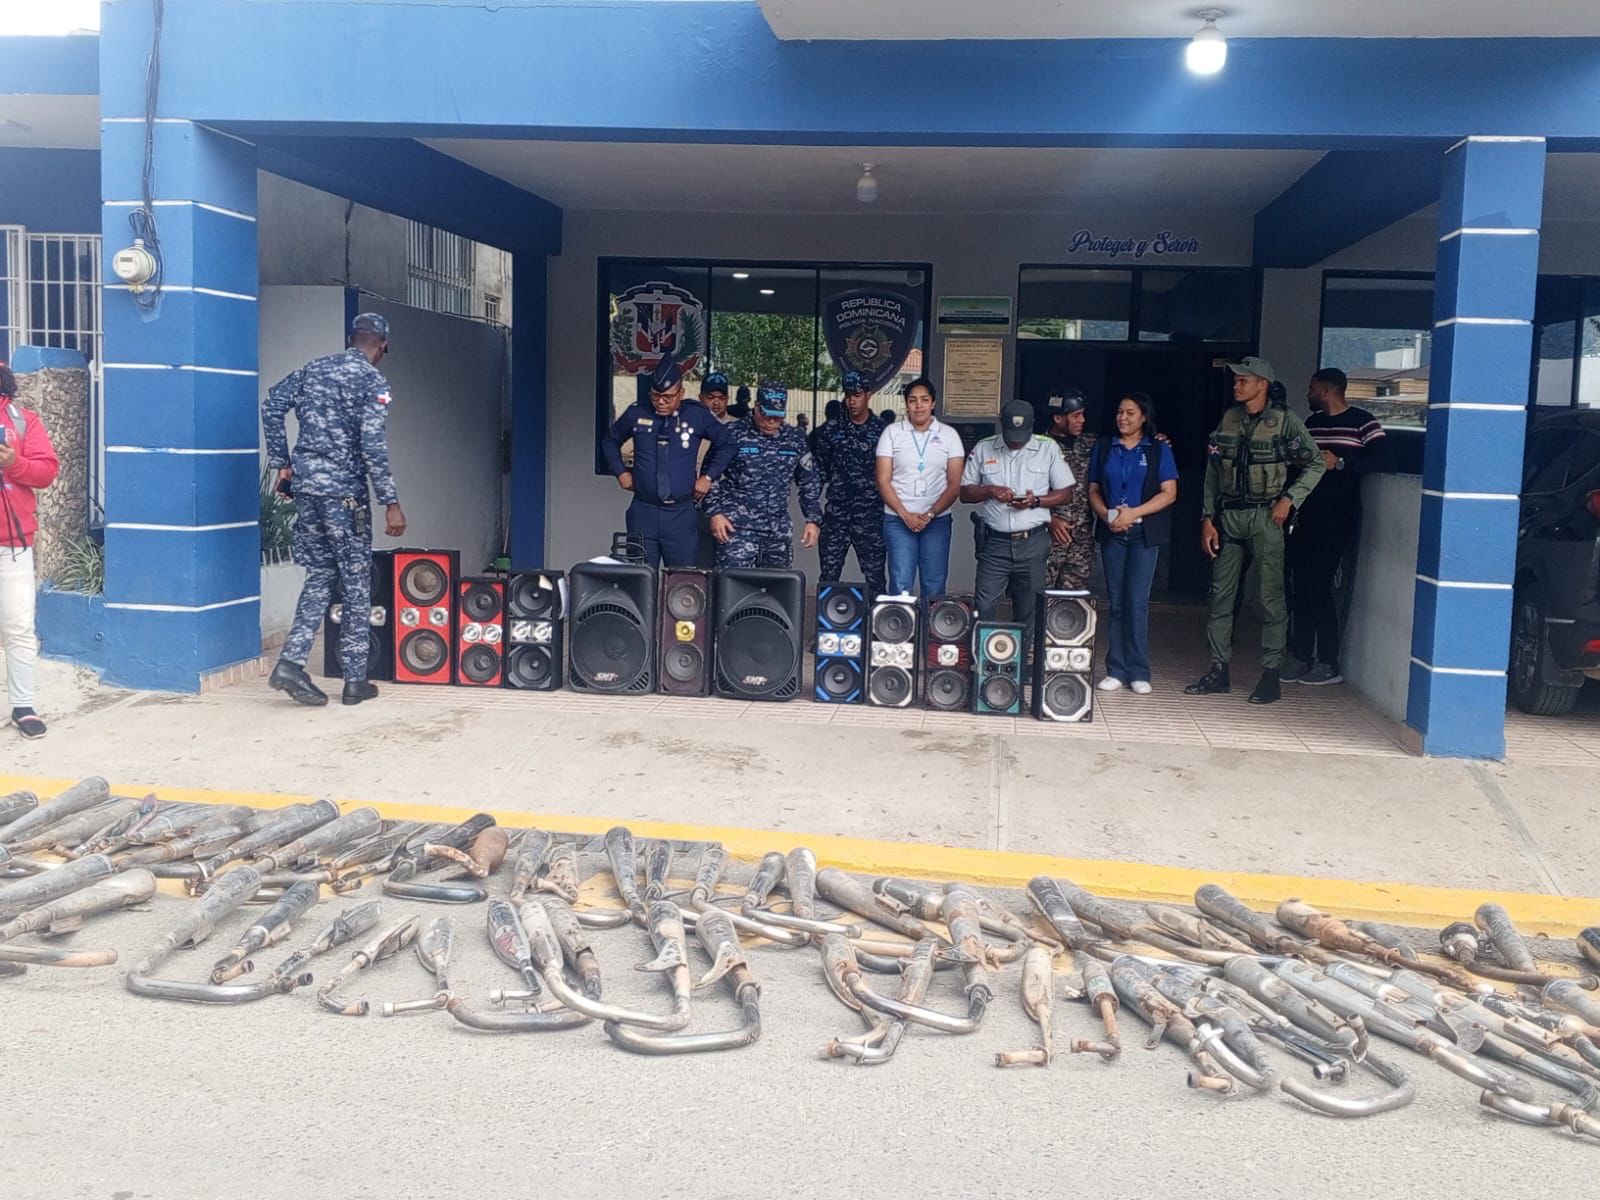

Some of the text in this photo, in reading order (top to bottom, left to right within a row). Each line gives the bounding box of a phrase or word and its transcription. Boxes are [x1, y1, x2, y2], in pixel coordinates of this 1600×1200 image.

[1067, 230, 1199, 258] Proteger y Servir
[836, 308, 906, 327] DOMINICANA
